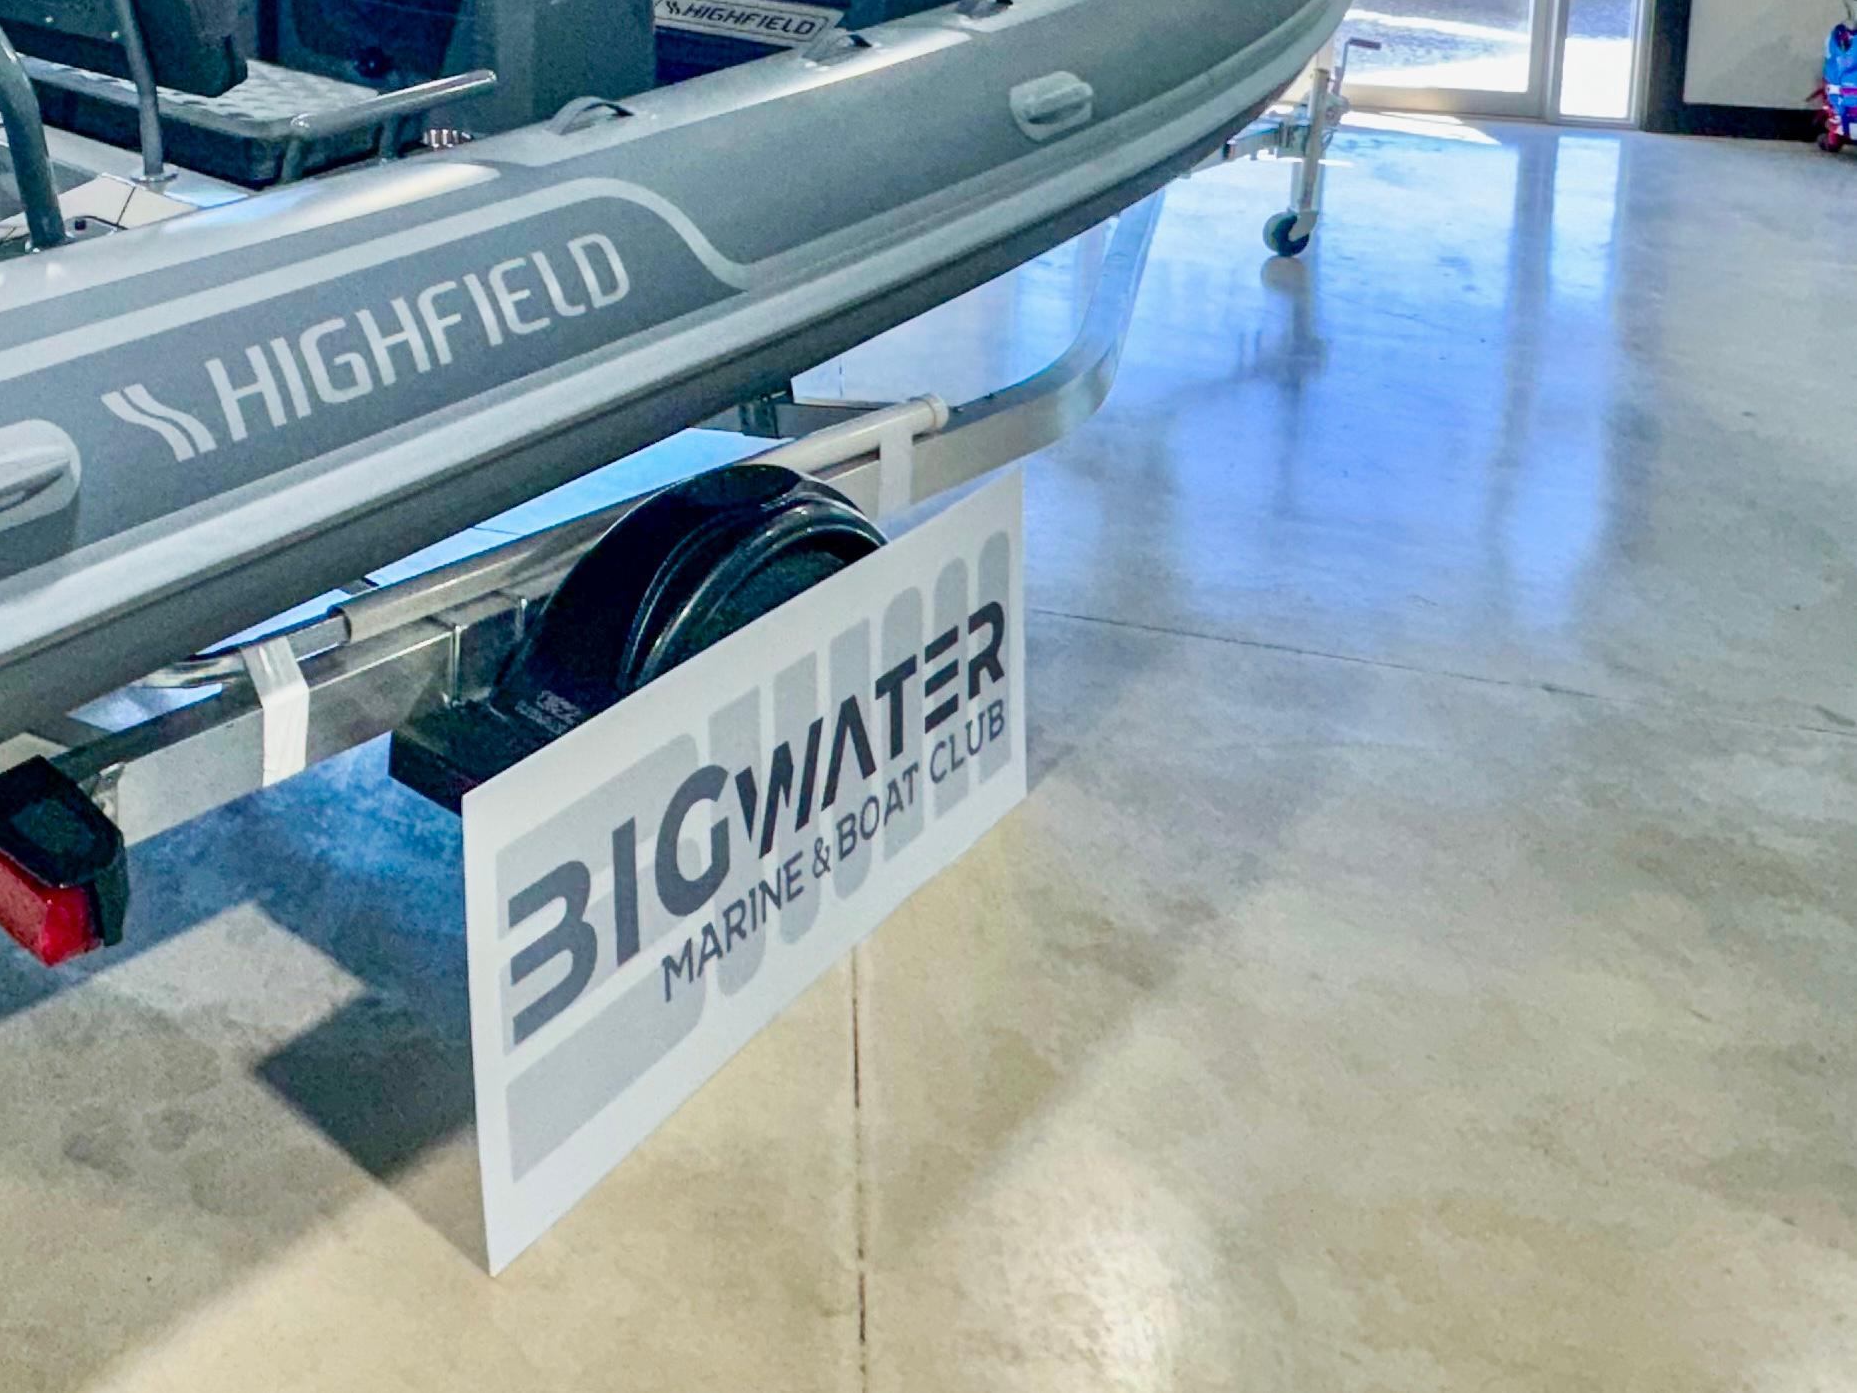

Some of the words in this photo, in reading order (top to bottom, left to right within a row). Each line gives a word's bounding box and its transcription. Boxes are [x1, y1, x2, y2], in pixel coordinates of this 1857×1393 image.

[682, 3, 816, 35] HIGHFIELD
[205, 233, 630, 442] HIGHFIELD
[662, 851, 804, 1002] MARINE
[812, 837, 832, 880] &
[836, 768, 919, 857] BOAT
[930, 701, 1006, 785] CLUB
